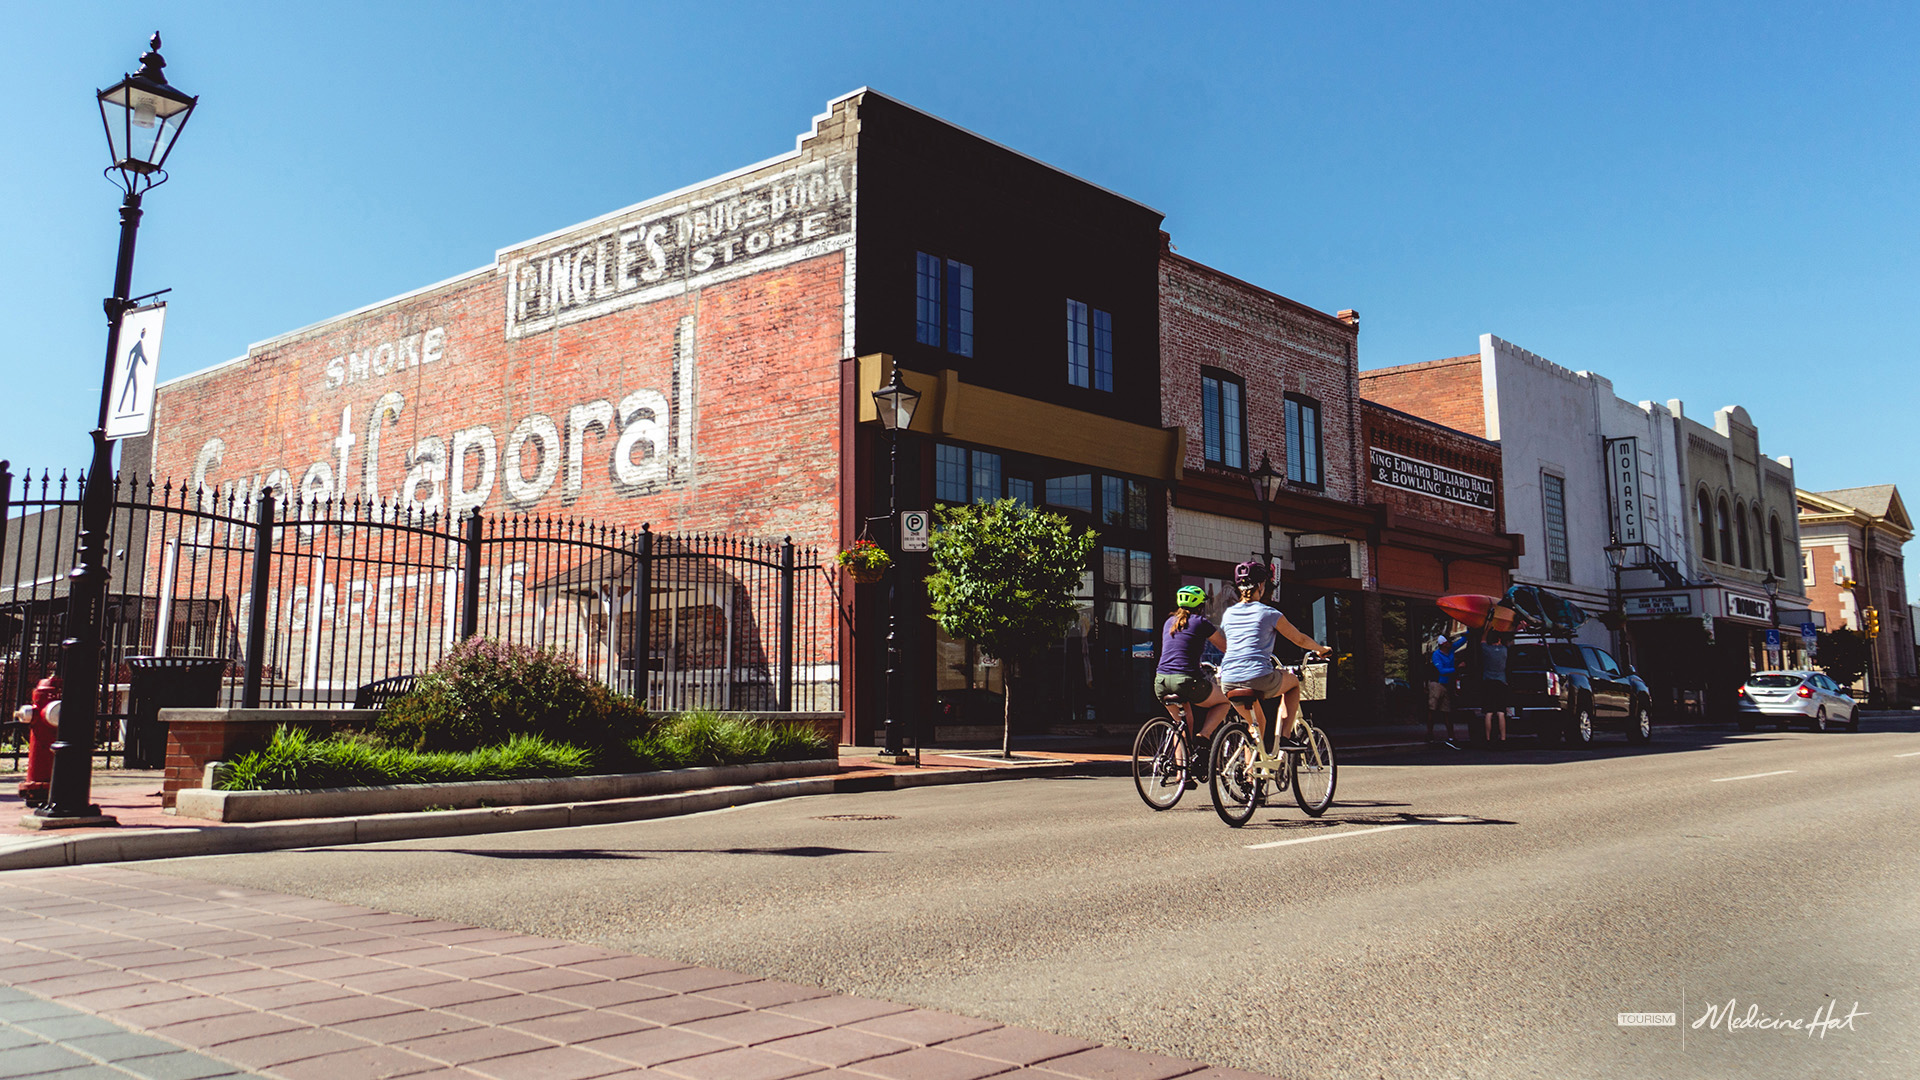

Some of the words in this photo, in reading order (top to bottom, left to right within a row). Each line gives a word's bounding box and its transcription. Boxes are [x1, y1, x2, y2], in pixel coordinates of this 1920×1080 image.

[675, 200, 741, 248] DRUG
[690, 211, 829, 272] STORE
[517, 224, 669, 320] PINGLE'S
[325, 326, 445, 389] SMOKE
[365, 315, 695, 564] Caporal
[1369, 450, 1392, 468] KING
[1394, 457, 1431, 479] EDWARD
[1433, 468, 1470, 489] BILLIARD
[1471, 478, 1493, 495] HALL
[1378, 468, 1389, 482] &
[1392, 471, 1441, 494] BOWLING
[1445, 485, 1479, 503] ALLEY
